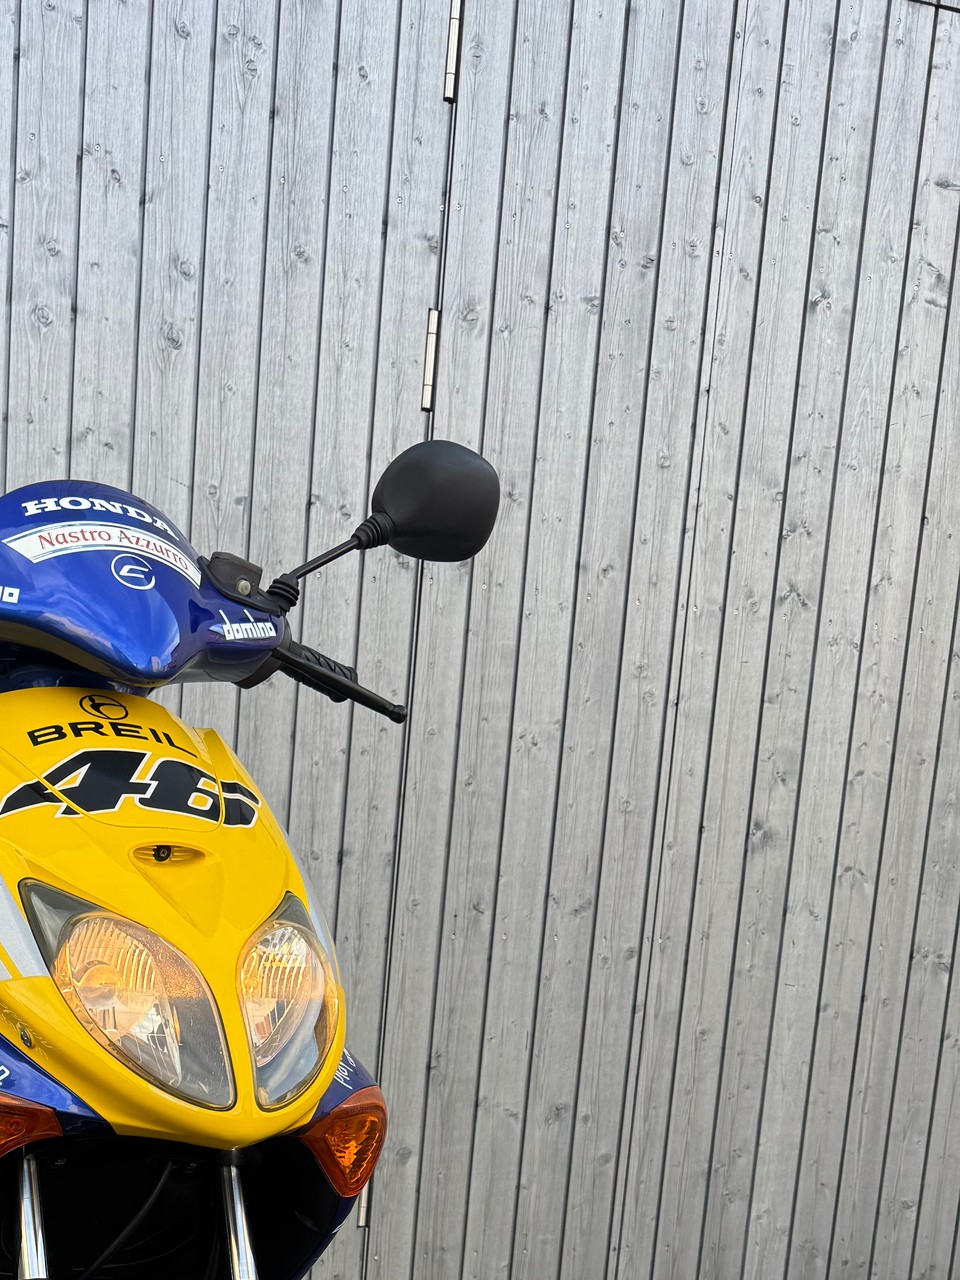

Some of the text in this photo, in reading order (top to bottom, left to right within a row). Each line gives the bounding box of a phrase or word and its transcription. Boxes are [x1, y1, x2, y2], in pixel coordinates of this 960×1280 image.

[21, 496, 180, 541] HONDA
[38, 528, 190, 571] Nastro Azzurro
[218, 609, 277, 641] domino
[26, 721, 198, 759] BREIL
